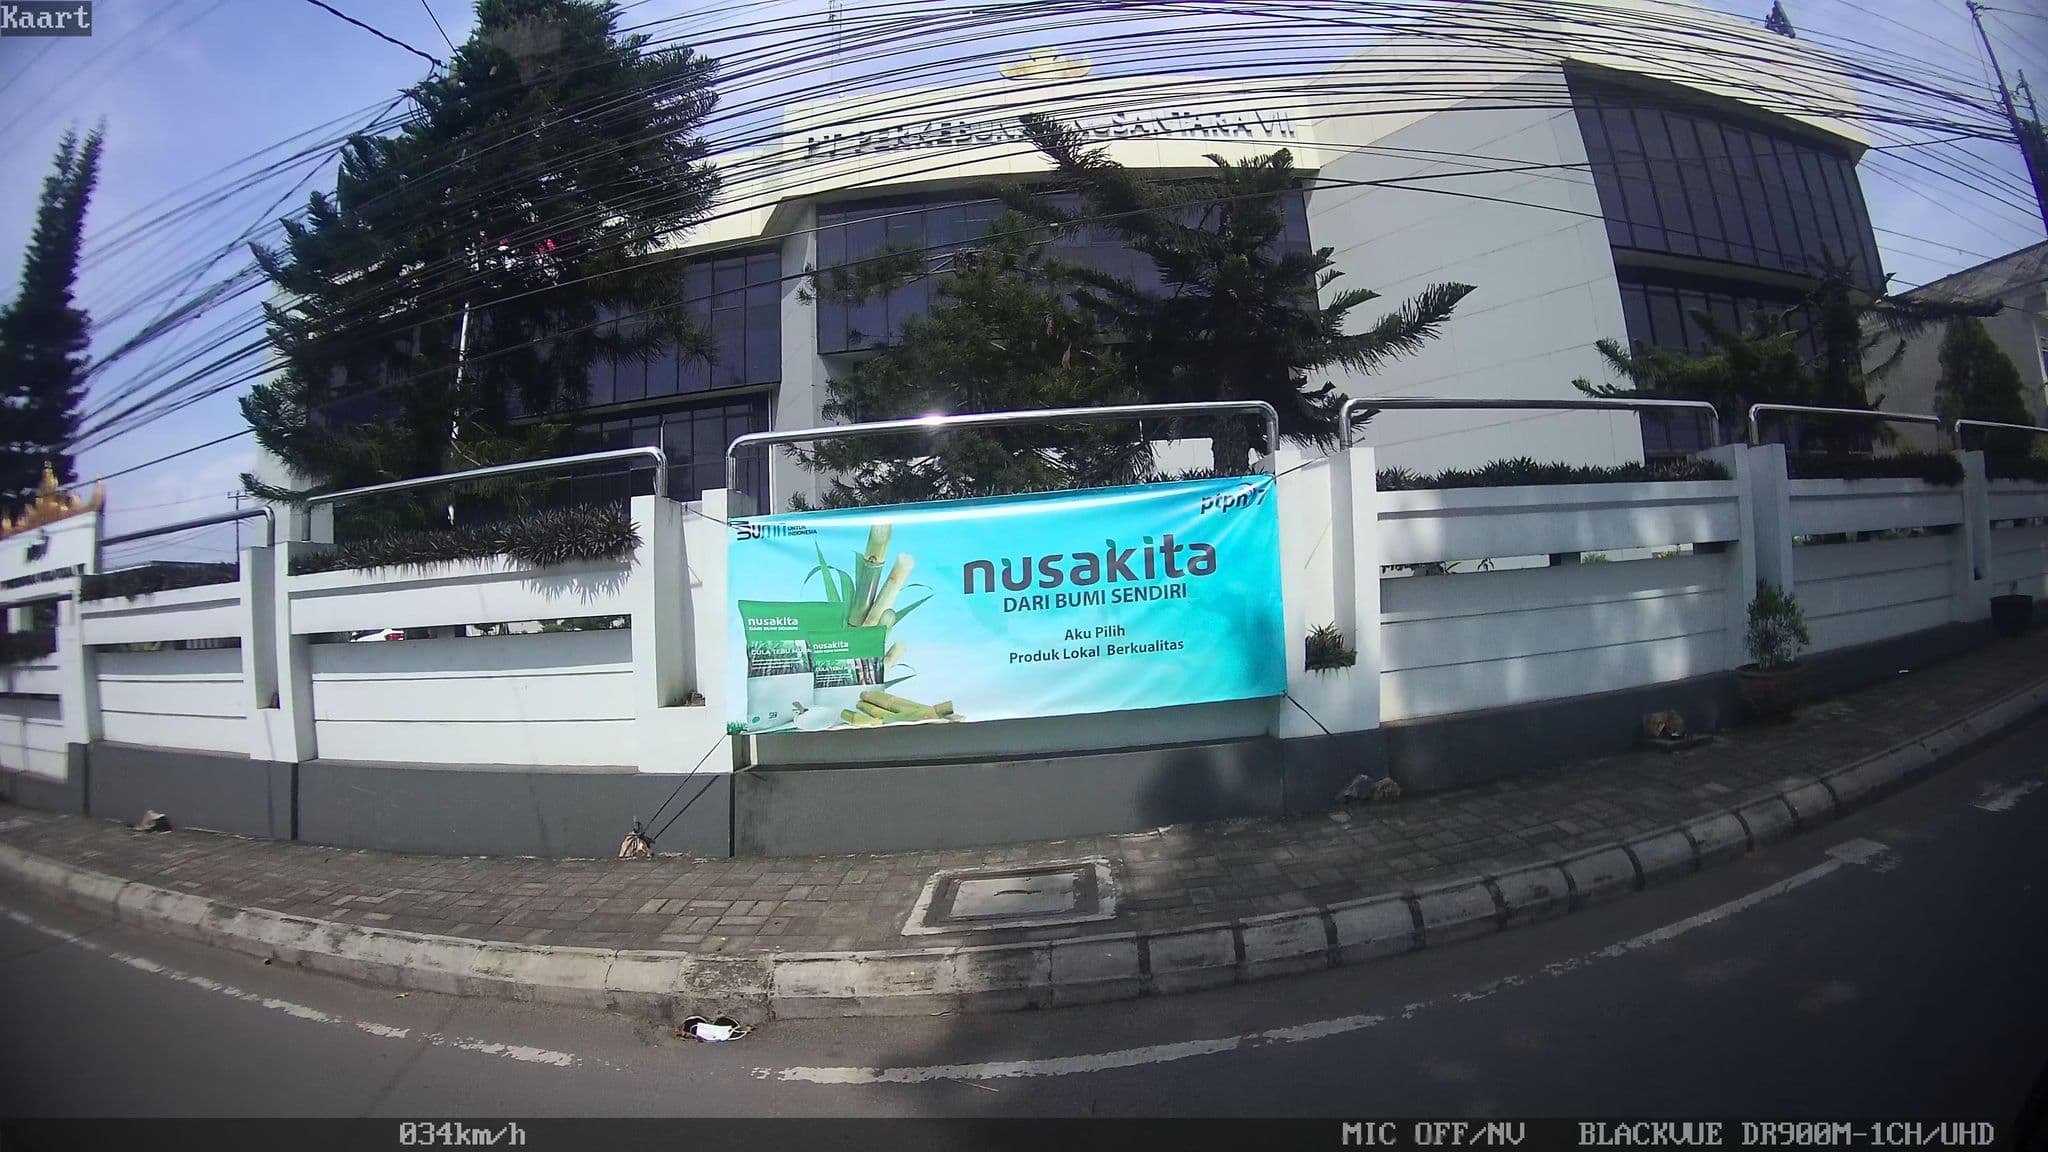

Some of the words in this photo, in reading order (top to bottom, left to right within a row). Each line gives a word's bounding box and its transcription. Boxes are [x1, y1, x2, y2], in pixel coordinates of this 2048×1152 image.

[963, 534, 1217, 595] nusakita
[1003, 594, 1050, 613] DARI
[1055, 590, 1106, 609] BUMI
[1111, 583, 1187, 604] SENDIRI
[748, 616, 799, 626] nusakita
[1064, 628, 1092, 641] Aku
[1095, 625, 1126, 639] Pilih
[812, 640, 849, 650] nusakita
[1009, 646, 1060, 664] Produk
[1063, 645, 1101, 661] Lokal
[1106, 639, 1185, 656] Berkualitas
